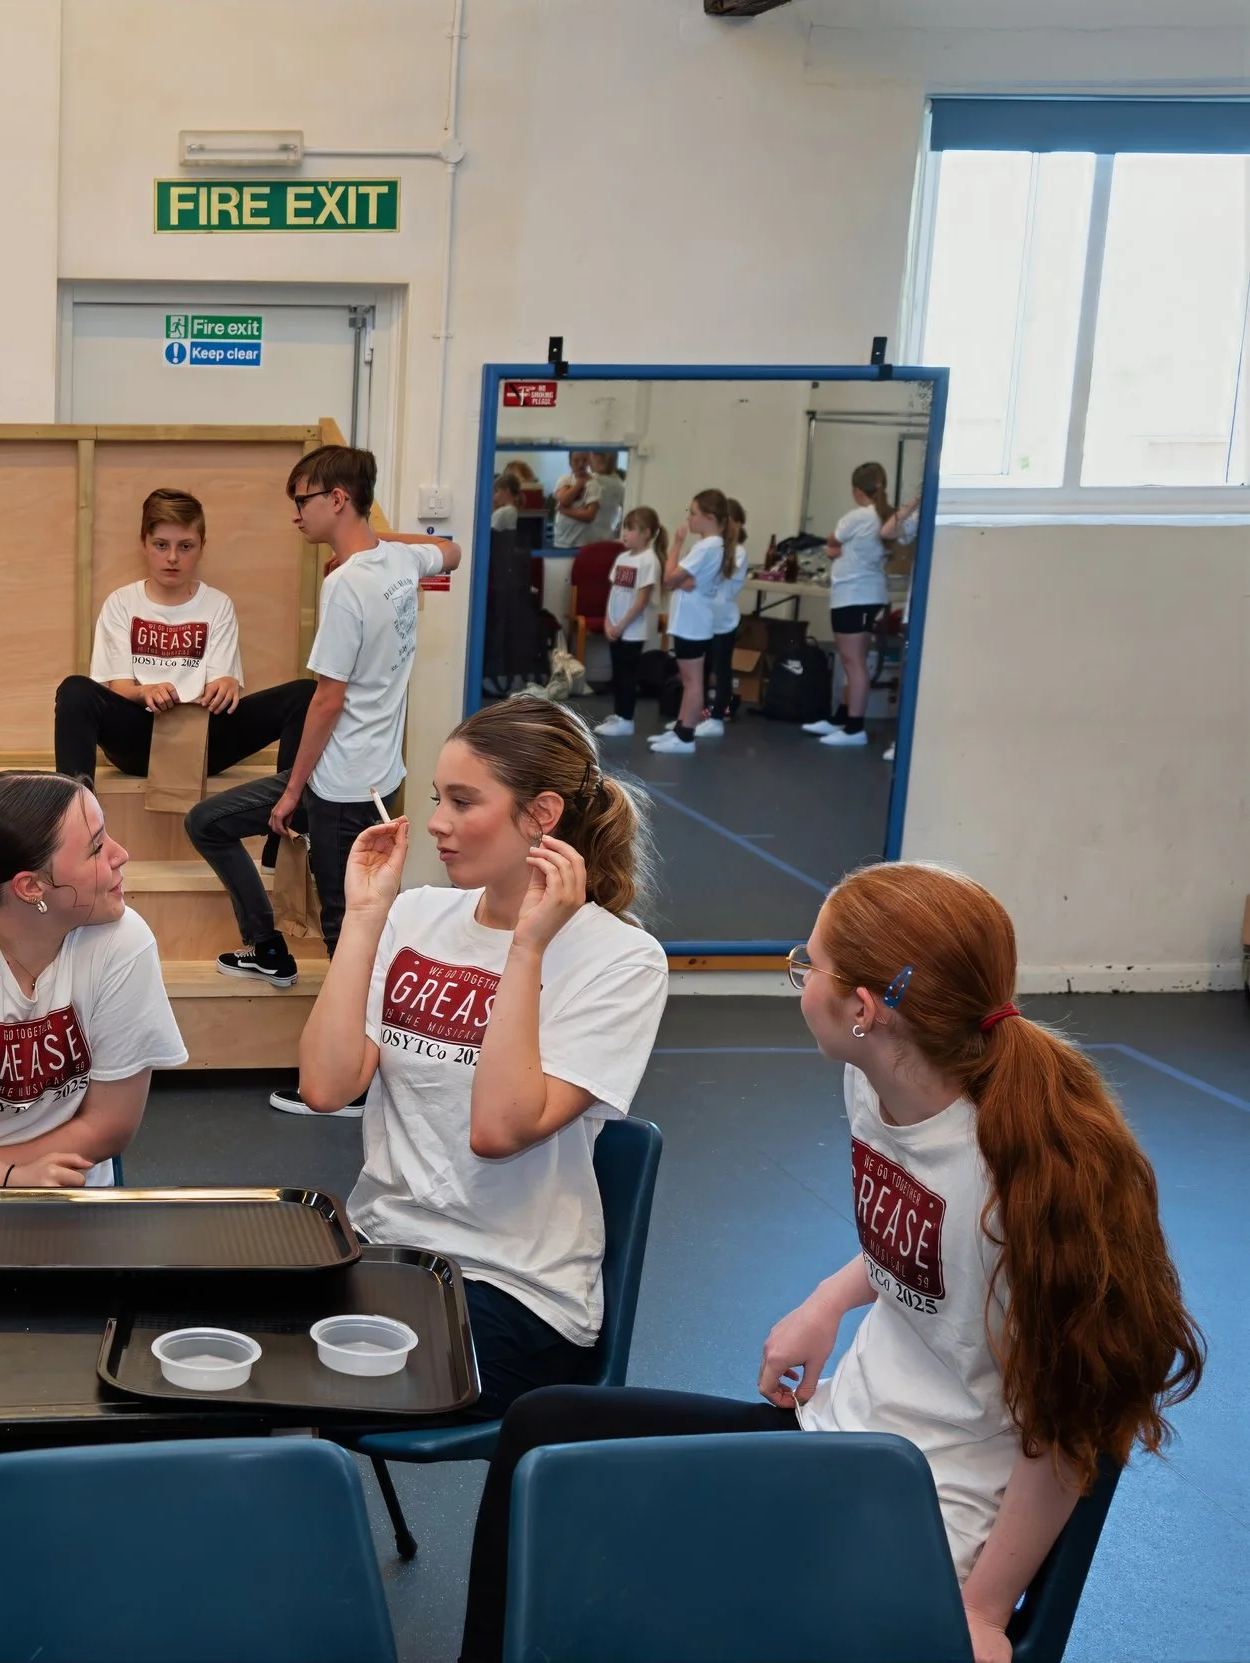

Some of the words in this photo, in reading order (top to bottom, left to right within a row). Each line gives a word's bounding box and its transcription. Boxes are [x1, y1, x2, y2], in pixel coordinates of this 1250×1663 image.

[169, 186, 271, 225] FIRE
[286, 185, 389, 225] EXIT
[193, 319, 225, 335] Fire
[227, 320, 259, 336] exit
[192, 347, 225, 362] Keep
[226, 348, 259, 360] clear
[137, 627, 203, 650] GREASE
[181, 658, 200, 668] 2025
[429, 965, 443, 978] WE
[445, 969, 457, 980] GO
[458, 970, 500, 991] TOGETH
[390, 971, 497, 1028] GREAS
[398, 1011, 421, 1027] THE
[427, 1021, 477, 1041] MUSICAL
[381, 1028, 447, 1060] OSYTCo
[52, 1076, 89, 1103] 2025
[863, 1154, 875, 1172] WE
[877, 1164, 888, 1180] GO
[892, 1172, 921, 1207] TOGETHER
[917, 1276, 930, 1289] 59
[895, 1282, 938, 1315] 2025
